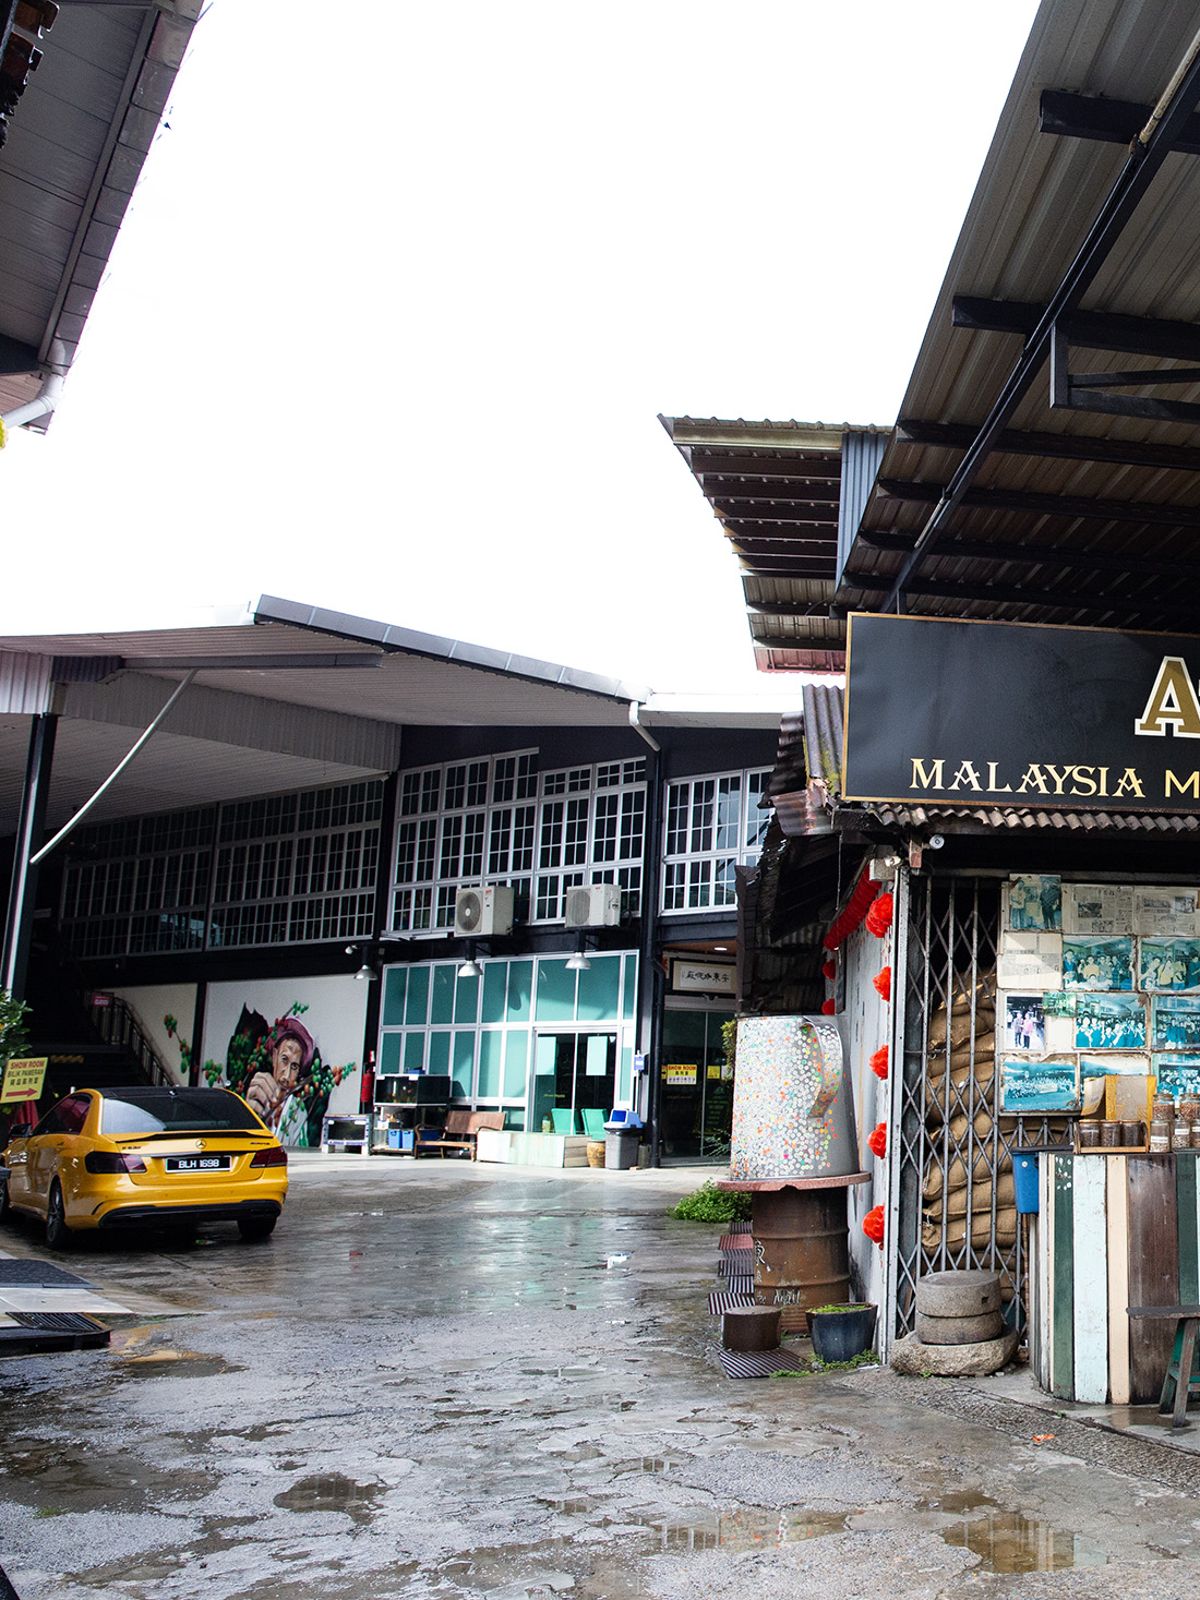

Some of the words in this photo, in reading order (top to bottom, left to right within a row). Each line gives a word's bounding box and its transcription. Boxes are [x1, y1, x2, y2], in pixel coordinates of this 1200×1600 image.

[909, 758, 1145, 798] MALAYSIA
[178, 1159, 197, 1168] BLH
[199, 1158, 220, 1168] 1698
